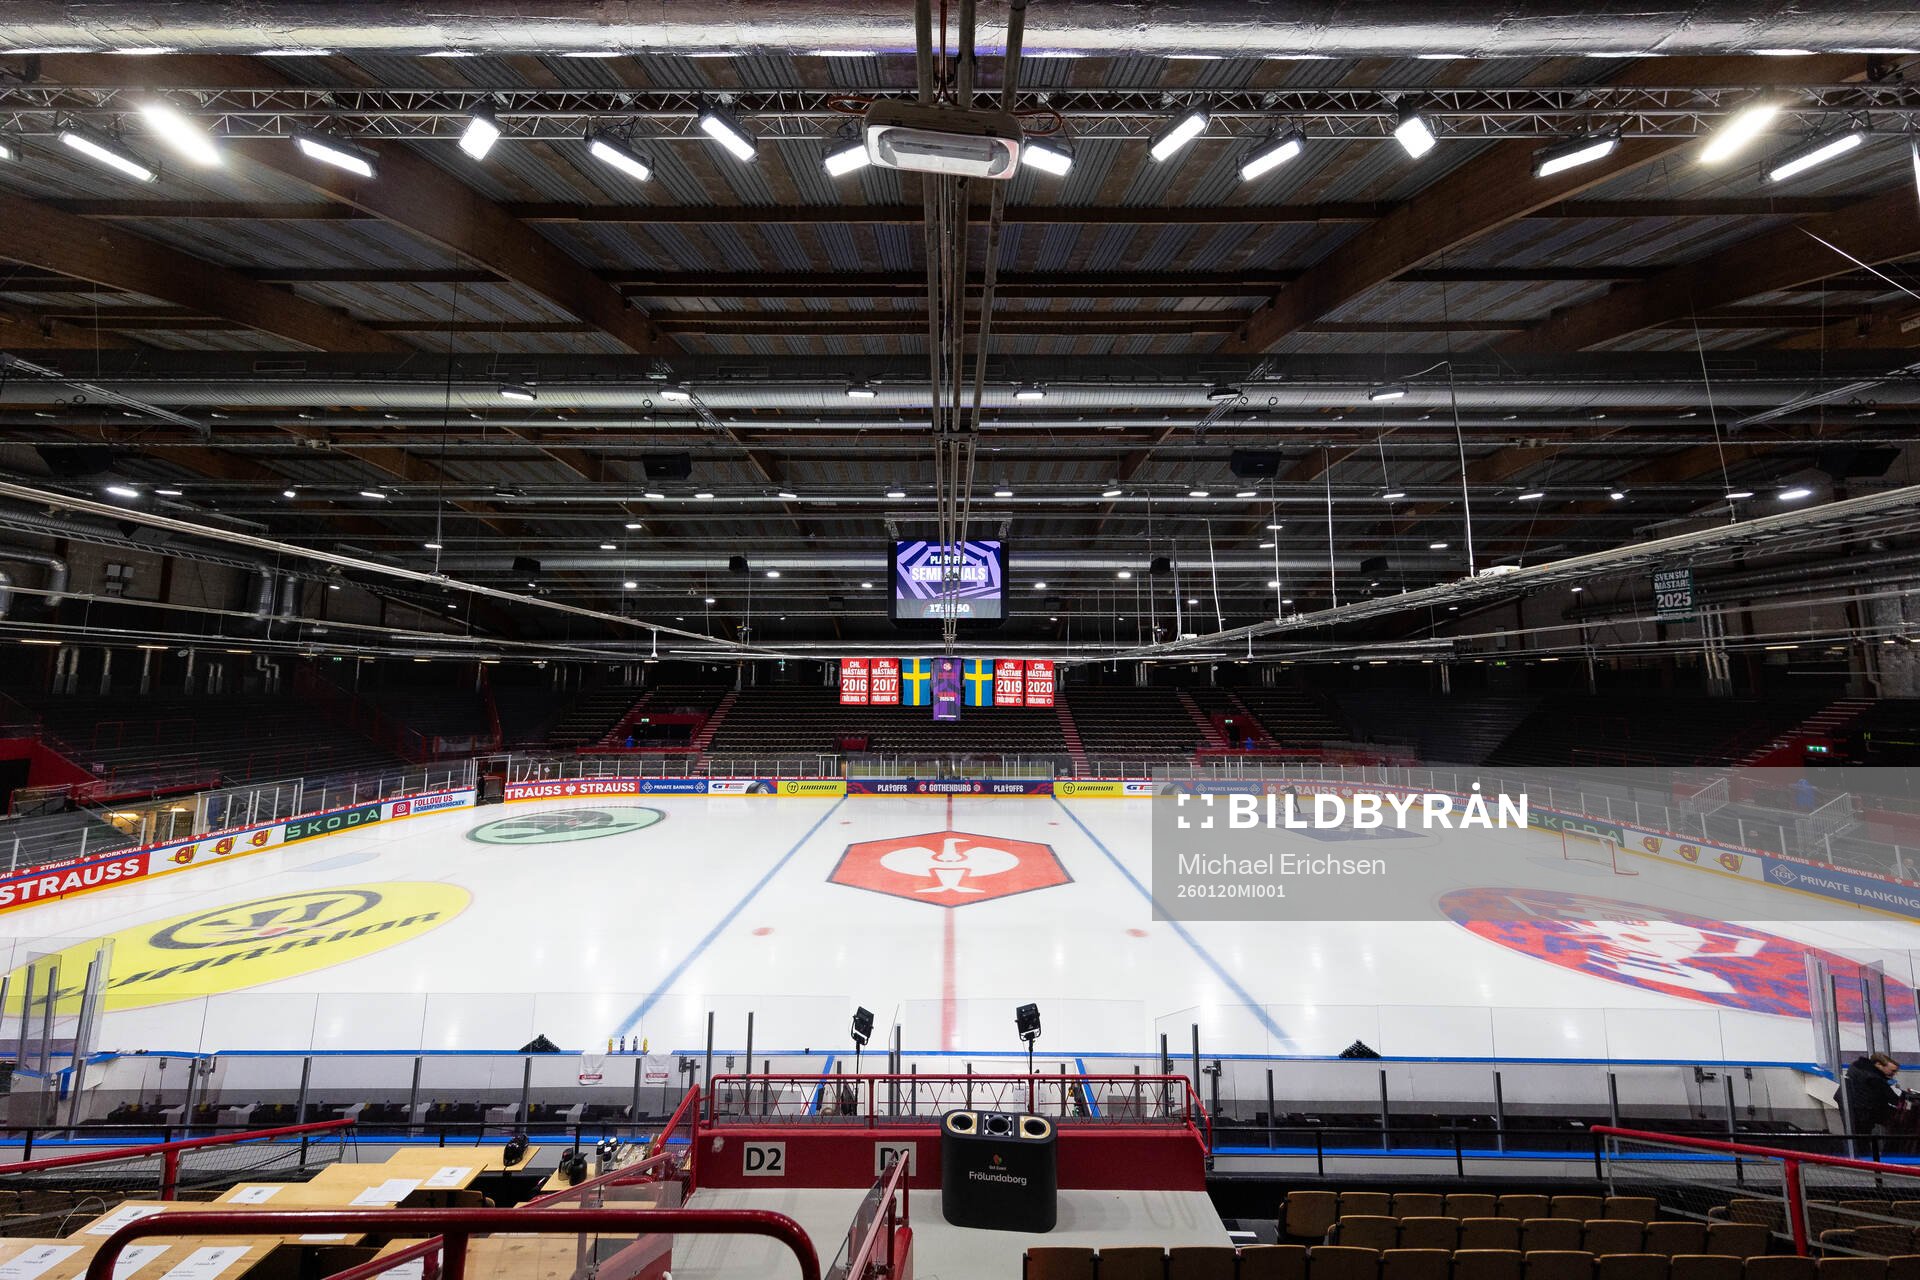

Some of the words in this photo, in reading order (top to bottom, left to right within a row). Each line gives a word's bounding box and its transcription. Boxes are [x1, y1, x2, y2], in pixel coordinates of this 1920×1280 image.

[1654, 570, 1689, 581] SVENSKA
[1656, 591, 1692, 608] 2025
[842, 679, 867, 691] 2016
[872, 679, 897, 691] 2017
[997, 680, 1022, 693] 2019
[1028, 681, 1052, 693] 2020
[505, 785, 561, 799] TRAUSS
[579, 782, 636, 793] STRAUSS
[928, 783, 972, 792] GOTHENBURG
[414, 796, 442, 807] FOLLOW
[443, 794, 453, 802] US
[40, 860, 75, 871] STRAUSS
[99, 847, 142, 859] WORKWEAR
[161, 837, 188, 846] STRAUSS
[1718, 842, 1757, 854] WORKWEAR
[1777, 853, 1809, 865] STRAUSS
[1833, 865, 1885, 880] WORKWEAR
[0, 858, 140, 905] STRAUSS
[1800, 874, 1850, 893] PRIVATE
[1854, 886, 1920, 909] BANKING
[745, 1147, 782, 1171] D2
[968, 1171, 1027, 1186] Frölundaborg
